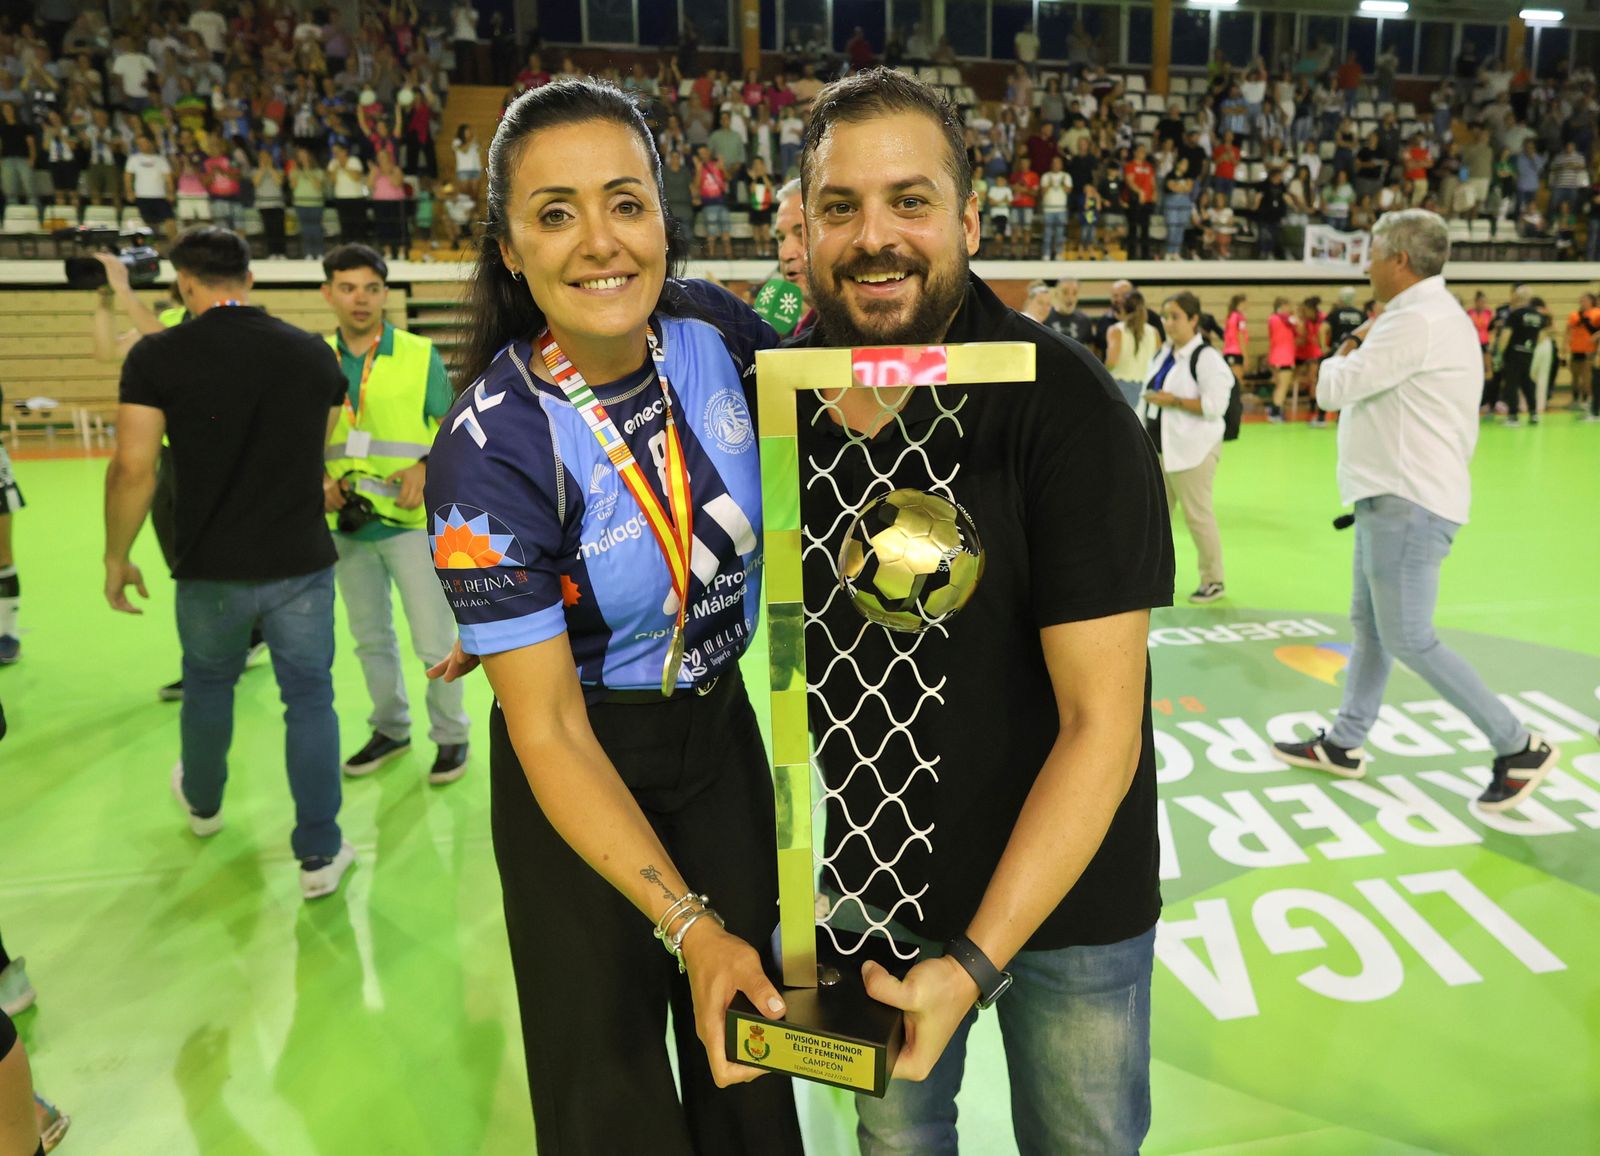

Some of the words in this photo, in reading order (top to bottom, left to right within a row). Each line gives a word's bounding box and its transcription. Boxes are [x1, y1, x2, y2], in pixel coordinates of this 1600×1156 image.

[464, 574, 515, 593] REINA
[692, 583, 748, 619] Málaga
[1154, 868, 1568, 1021] LIGA
[785, 1032, 820, 1046] DIVISIÓN
[821, 1040, 832, 1050] DE
[833, 1043, 863, 1056] HONOR
[793, 1042, 813, 1055] ÉLITE
[814, 1048, 854, 1063] FEMENINA
[802, 1056, 844, 1072] CAMPEÓN
